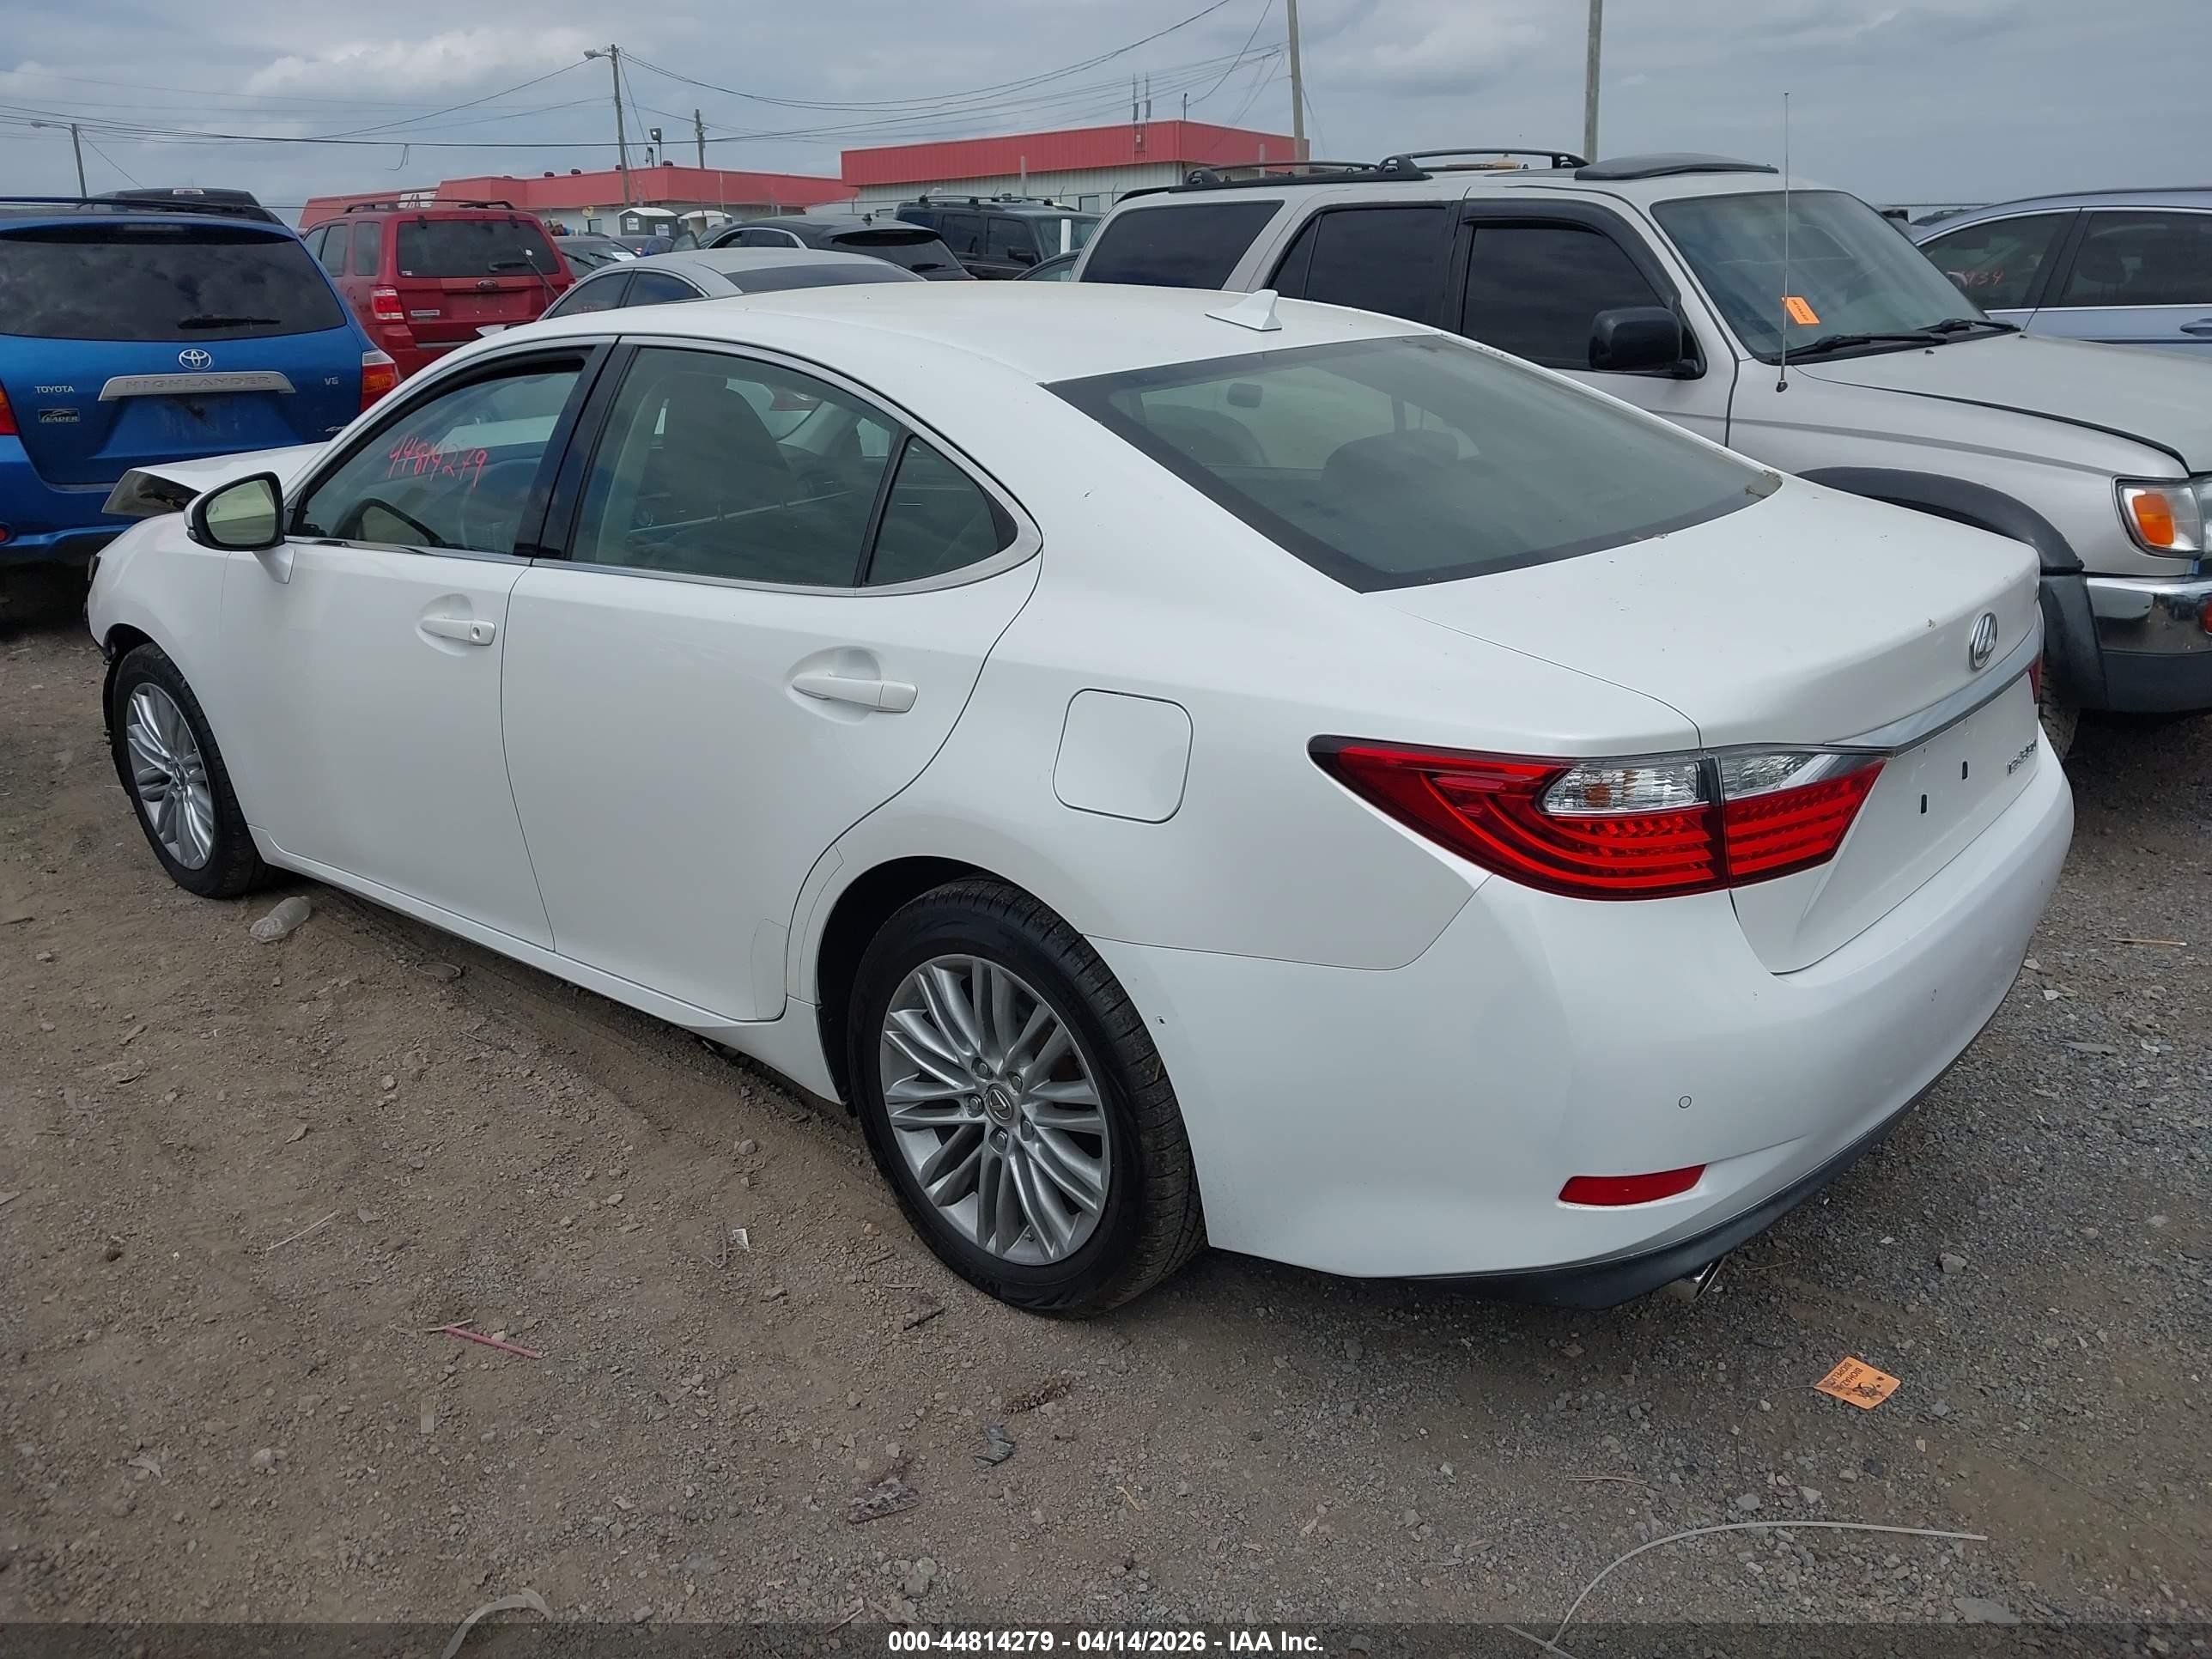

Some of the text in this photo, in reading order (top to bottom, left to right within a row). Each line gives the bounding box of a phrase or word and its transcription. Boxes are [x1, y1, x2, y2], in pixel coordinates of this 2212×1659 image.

[125, 376, 272, 388] HIGHLANDER
[324, 377, 339, 386] V6
[34, 385, 75, 394] TOYOTA
